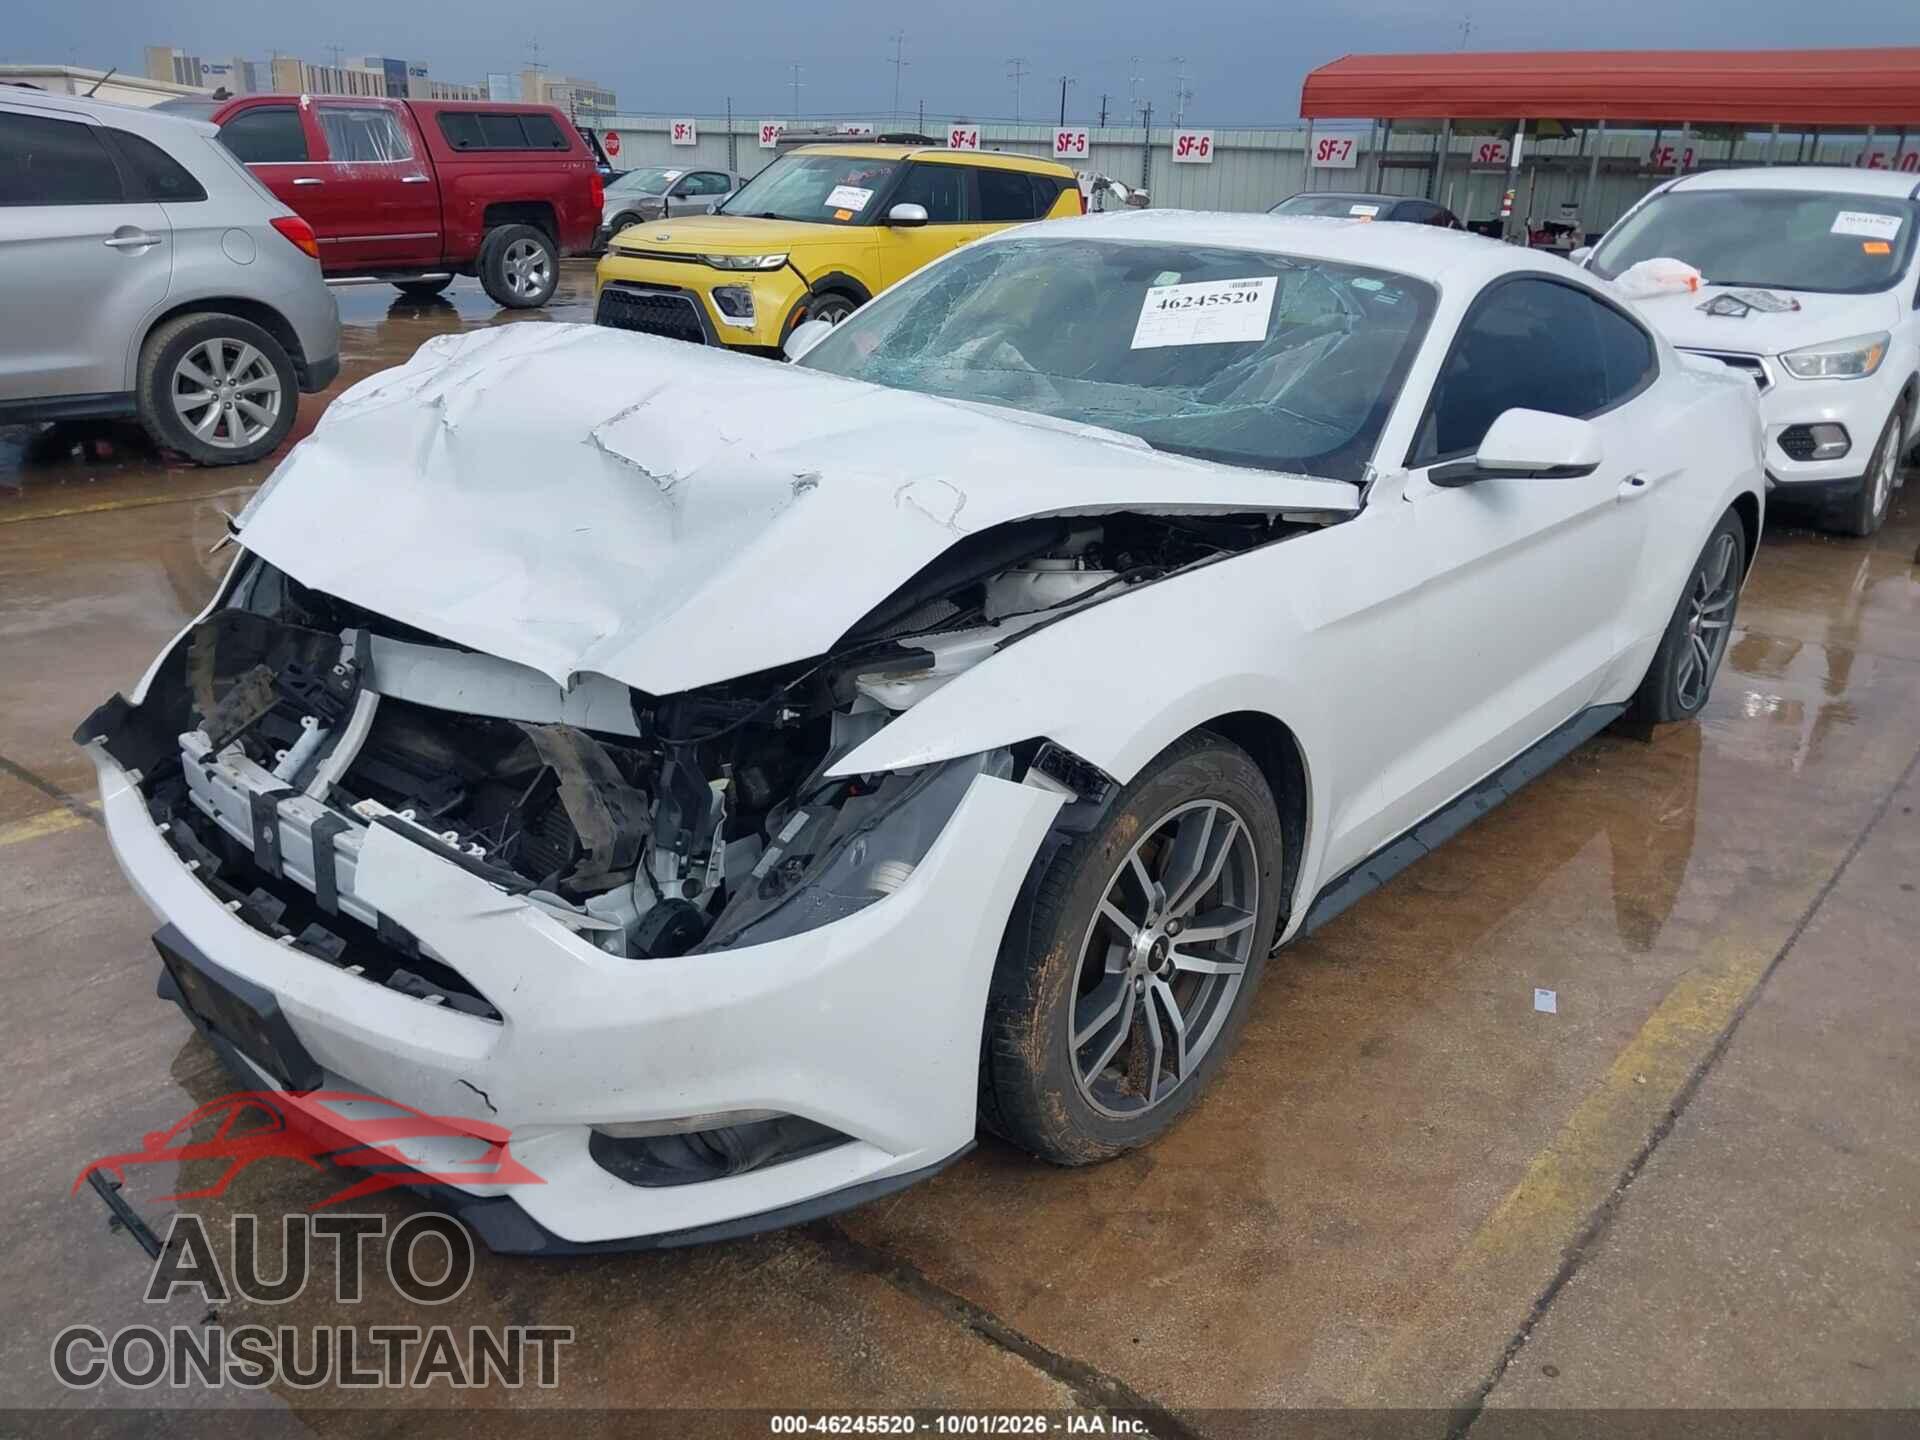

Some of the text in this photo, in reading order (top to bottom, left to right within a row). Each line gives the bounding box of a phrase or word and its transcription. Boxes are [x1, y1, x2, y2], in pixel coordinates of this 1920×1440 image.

[674, 123, 692, 140] SF-1
[951, 130, 977, 149] SF-4
[1057, 132, 1086, 152] SF-5
[1177, 136, 1210, 157] SF-6
[1317, 139, 1353, 161] SF-7
[1478, 143, 1506, 164] SF-
[1156, 291, 1259, 310] 46245520
